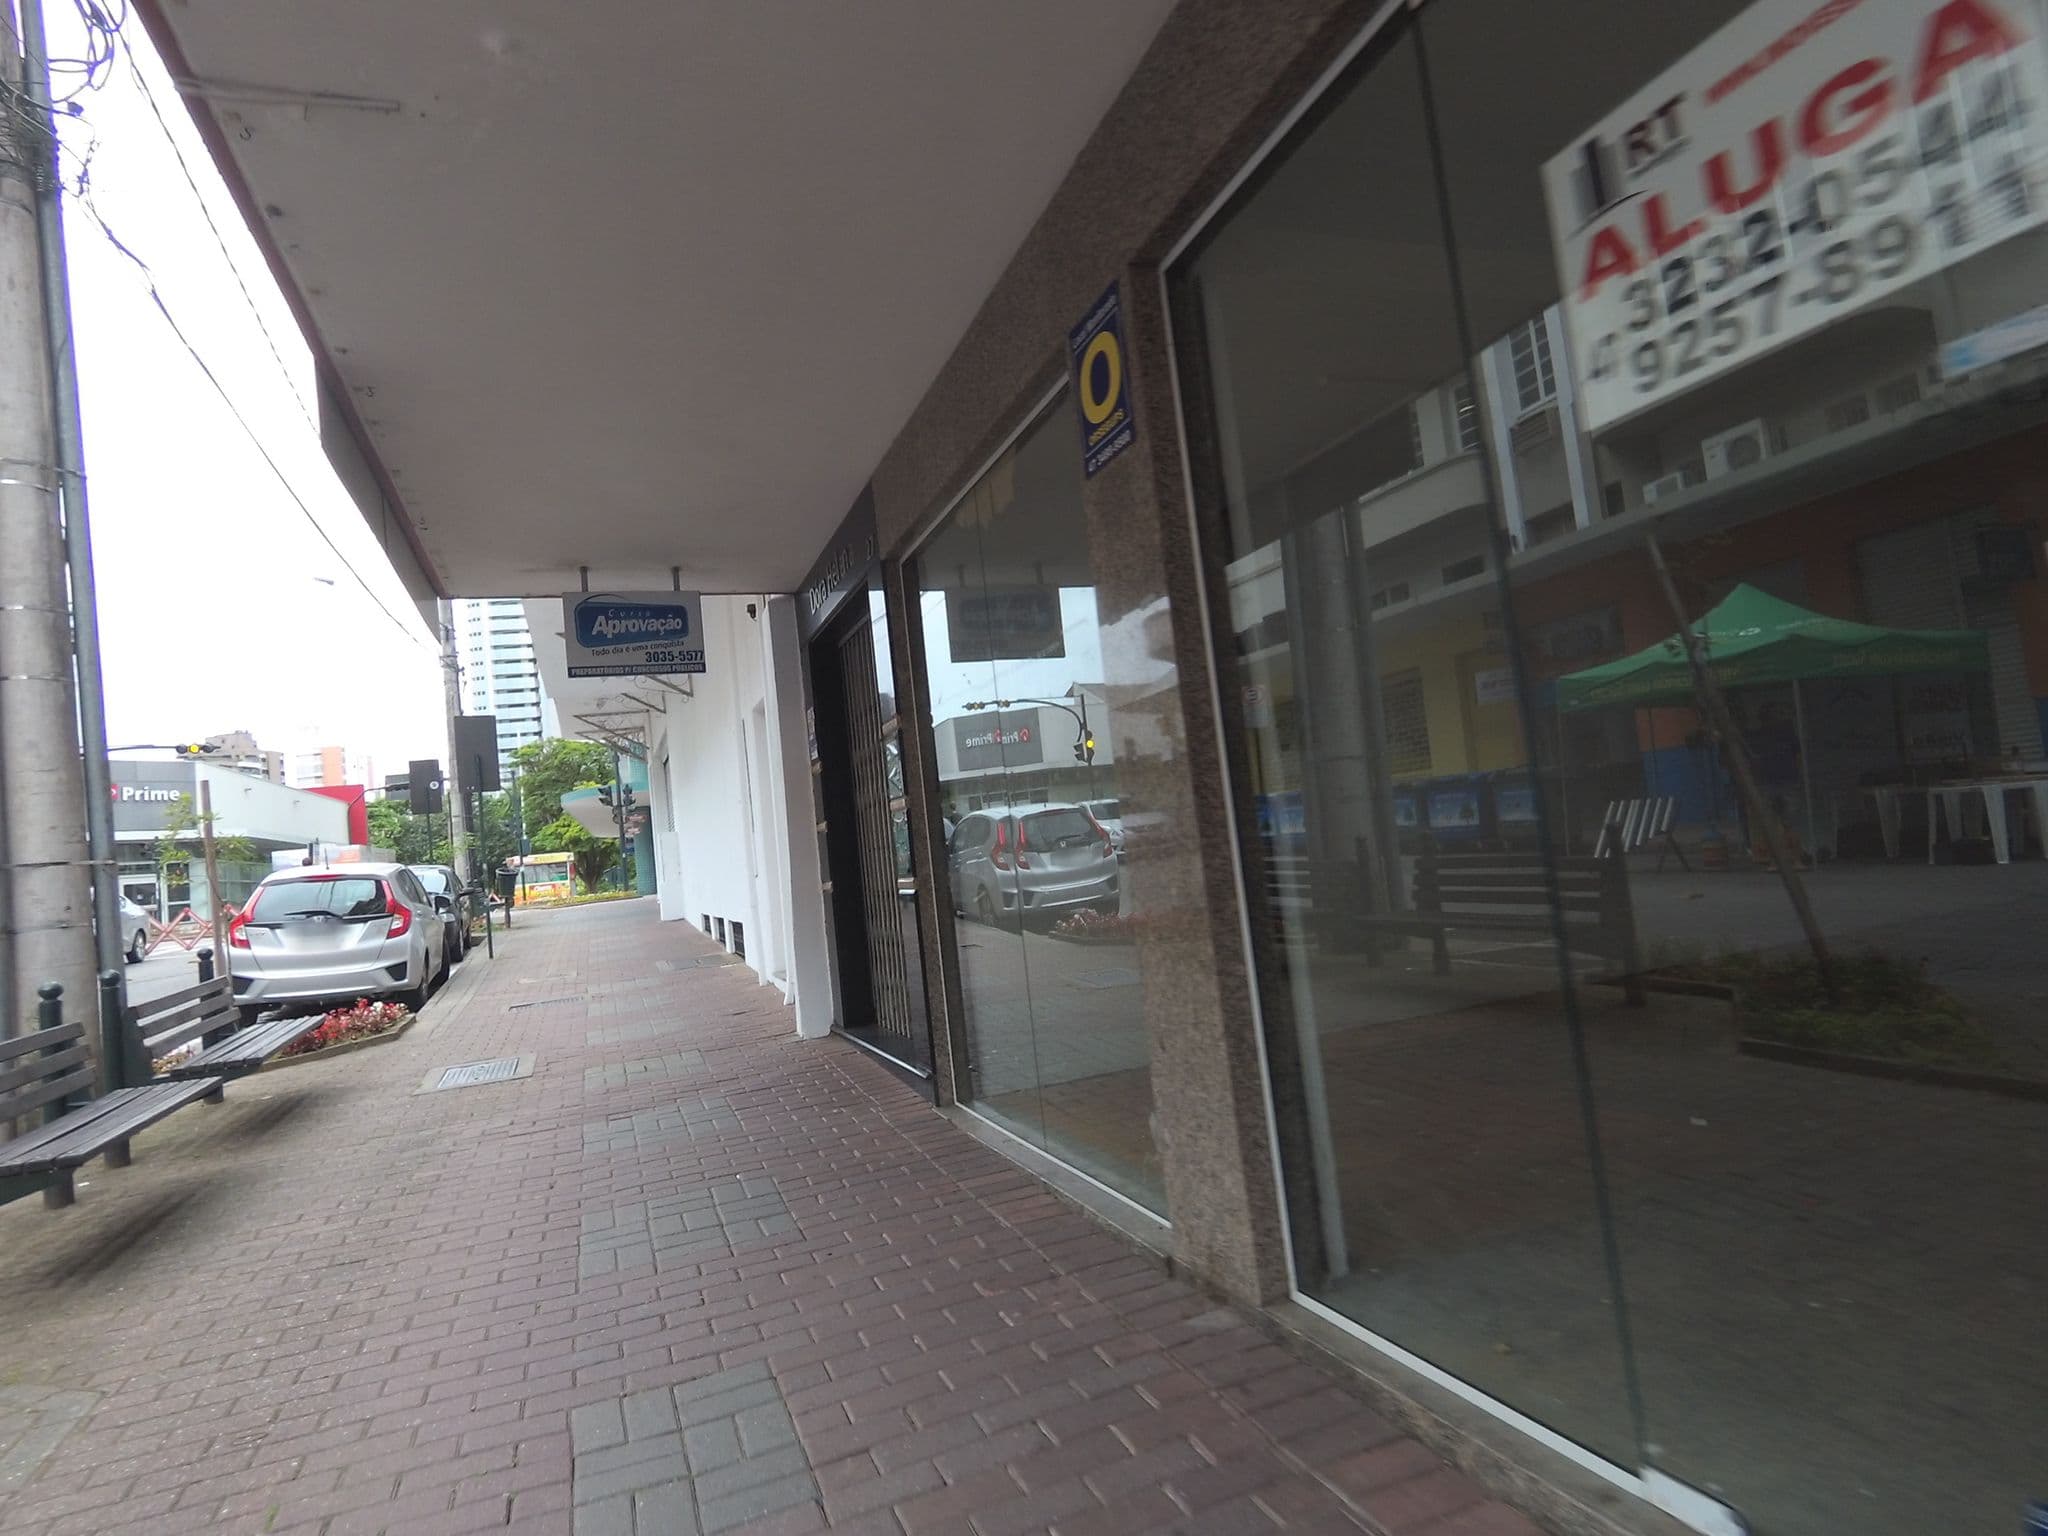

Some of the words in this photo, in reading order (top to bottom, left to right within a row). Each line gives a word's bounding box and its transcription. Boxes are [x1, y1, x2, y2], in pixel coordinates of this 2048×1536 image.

[1578, 0, 2034, 302] ALUGA
[591, 614, 683, 638] Aprovação
[122, 786, 180, 801] Prime
